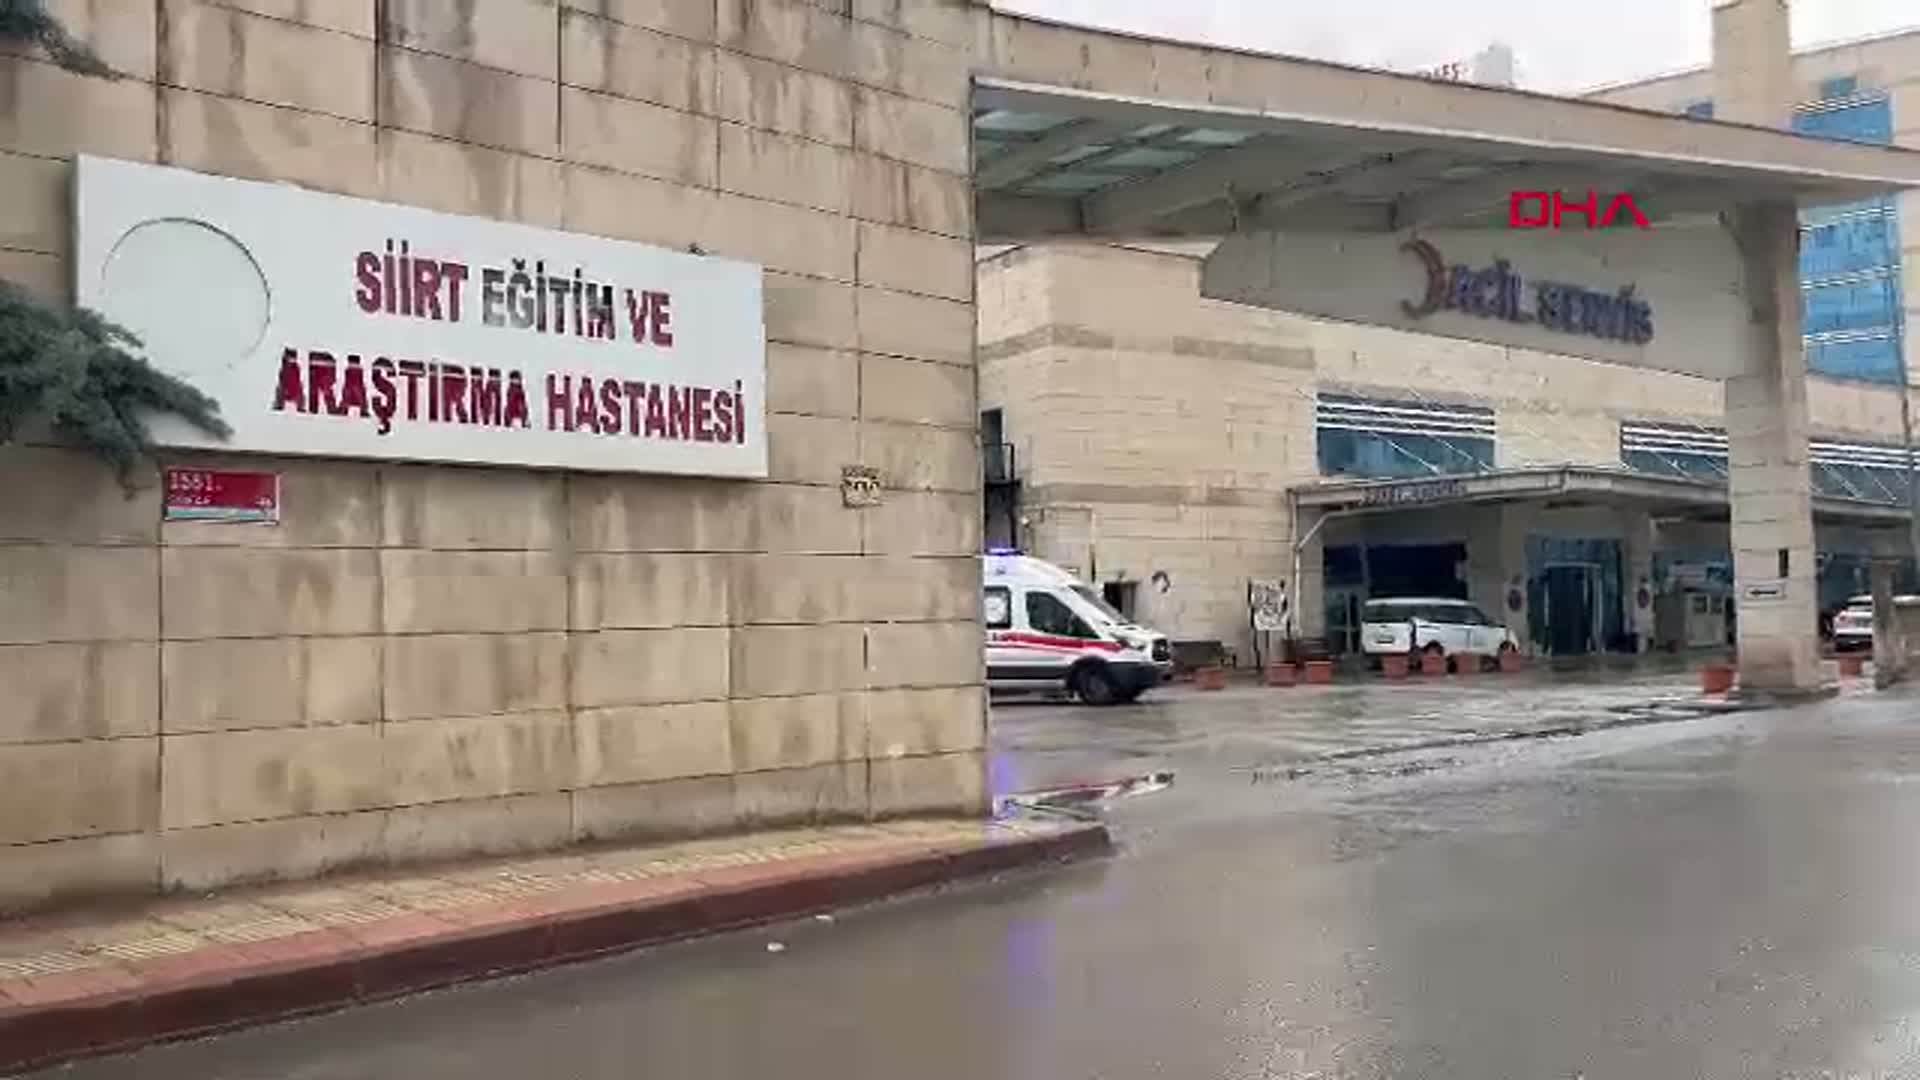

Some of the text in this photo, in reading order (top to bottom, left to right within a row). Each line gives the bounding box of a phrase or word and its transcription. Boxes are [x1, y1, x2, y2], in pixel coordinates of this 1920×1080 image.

[355, 238, 673, 347] SİİRT EĞİTİM VE
[273, 347, 746, 445] ARAŞTIRMA HASTANESİ
